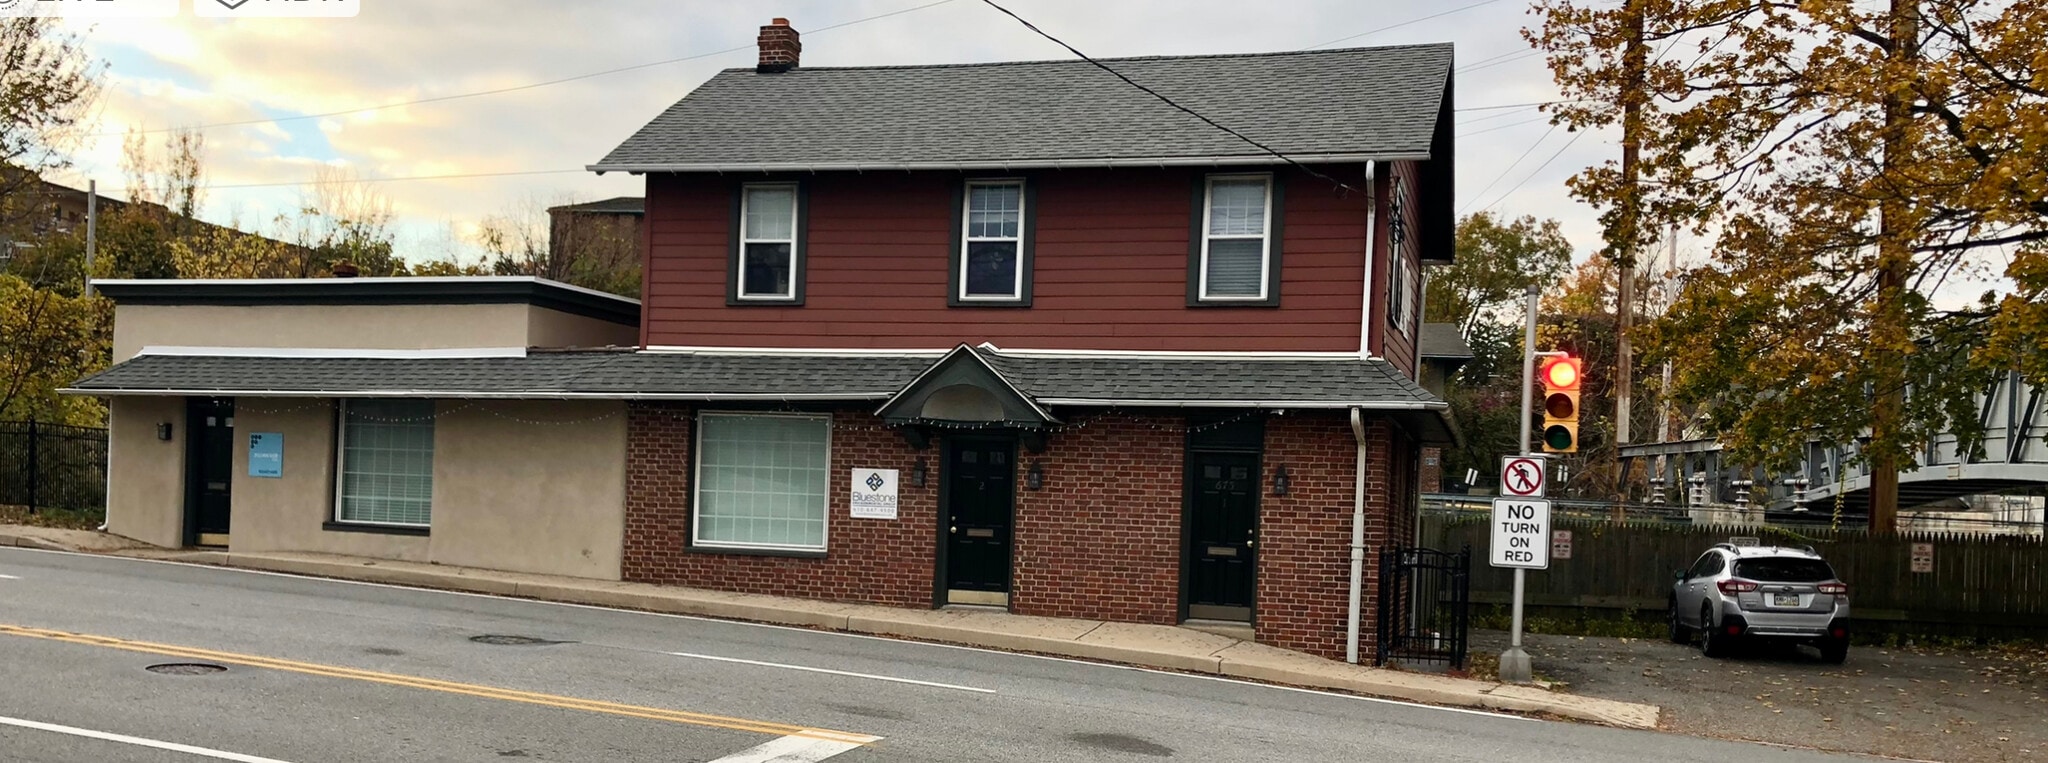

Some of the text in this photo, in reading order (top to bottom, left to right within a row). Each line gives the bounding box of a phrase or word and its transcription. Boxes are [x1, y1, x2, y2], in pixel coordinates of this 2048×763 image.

[853, 492, 896, 502] Bluestone
[1508, 505, 1534, 519] NO
[1502, 522, 1539, 534] TURN
[1510, 537, 1529, 548] ON
[1505, 550, 1533, 562] RED
